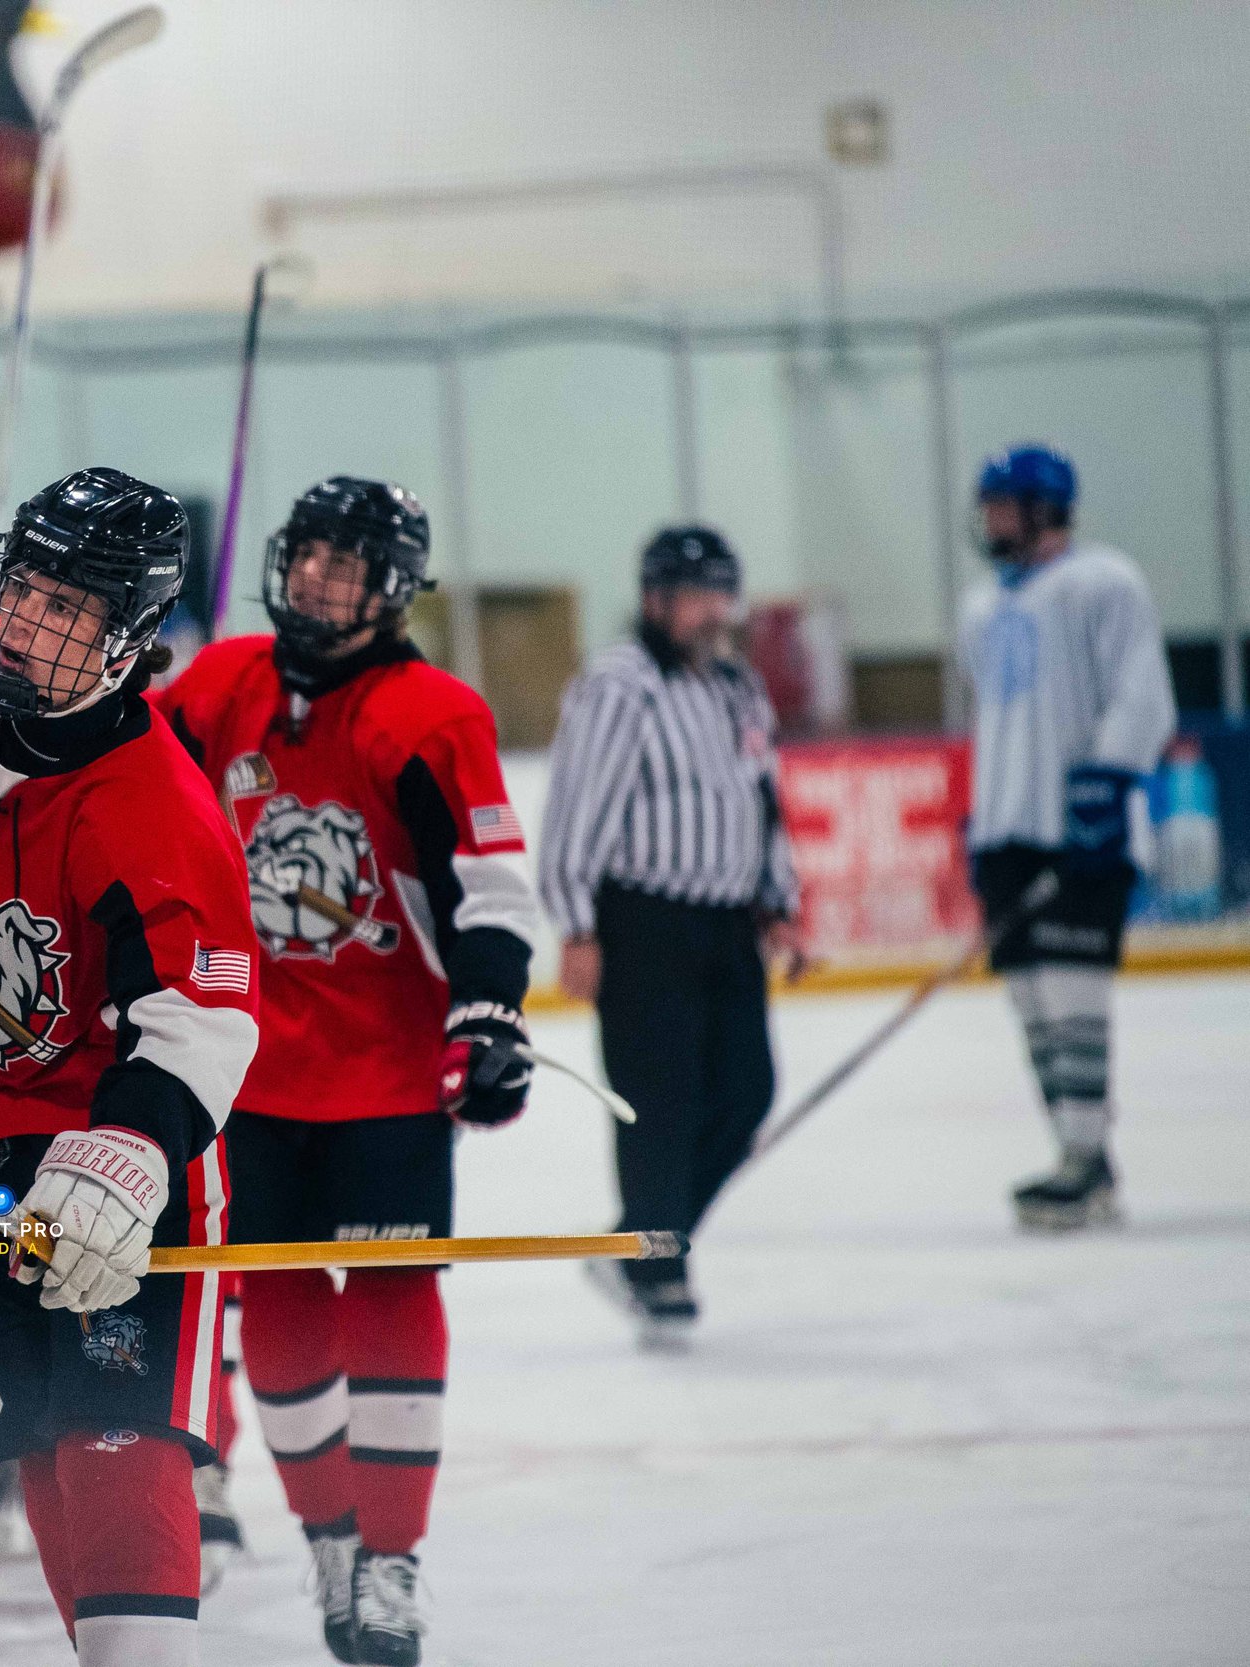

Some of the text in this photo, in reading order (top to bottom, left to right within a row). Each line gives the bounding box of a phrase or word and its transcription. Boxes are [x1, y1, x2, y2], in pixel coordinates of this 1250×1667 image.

[25, 529, 69, 553] BAUER
[148, 565, 178, 576] BAUER
[42, 1138, 160, 1211] ARRIOR
